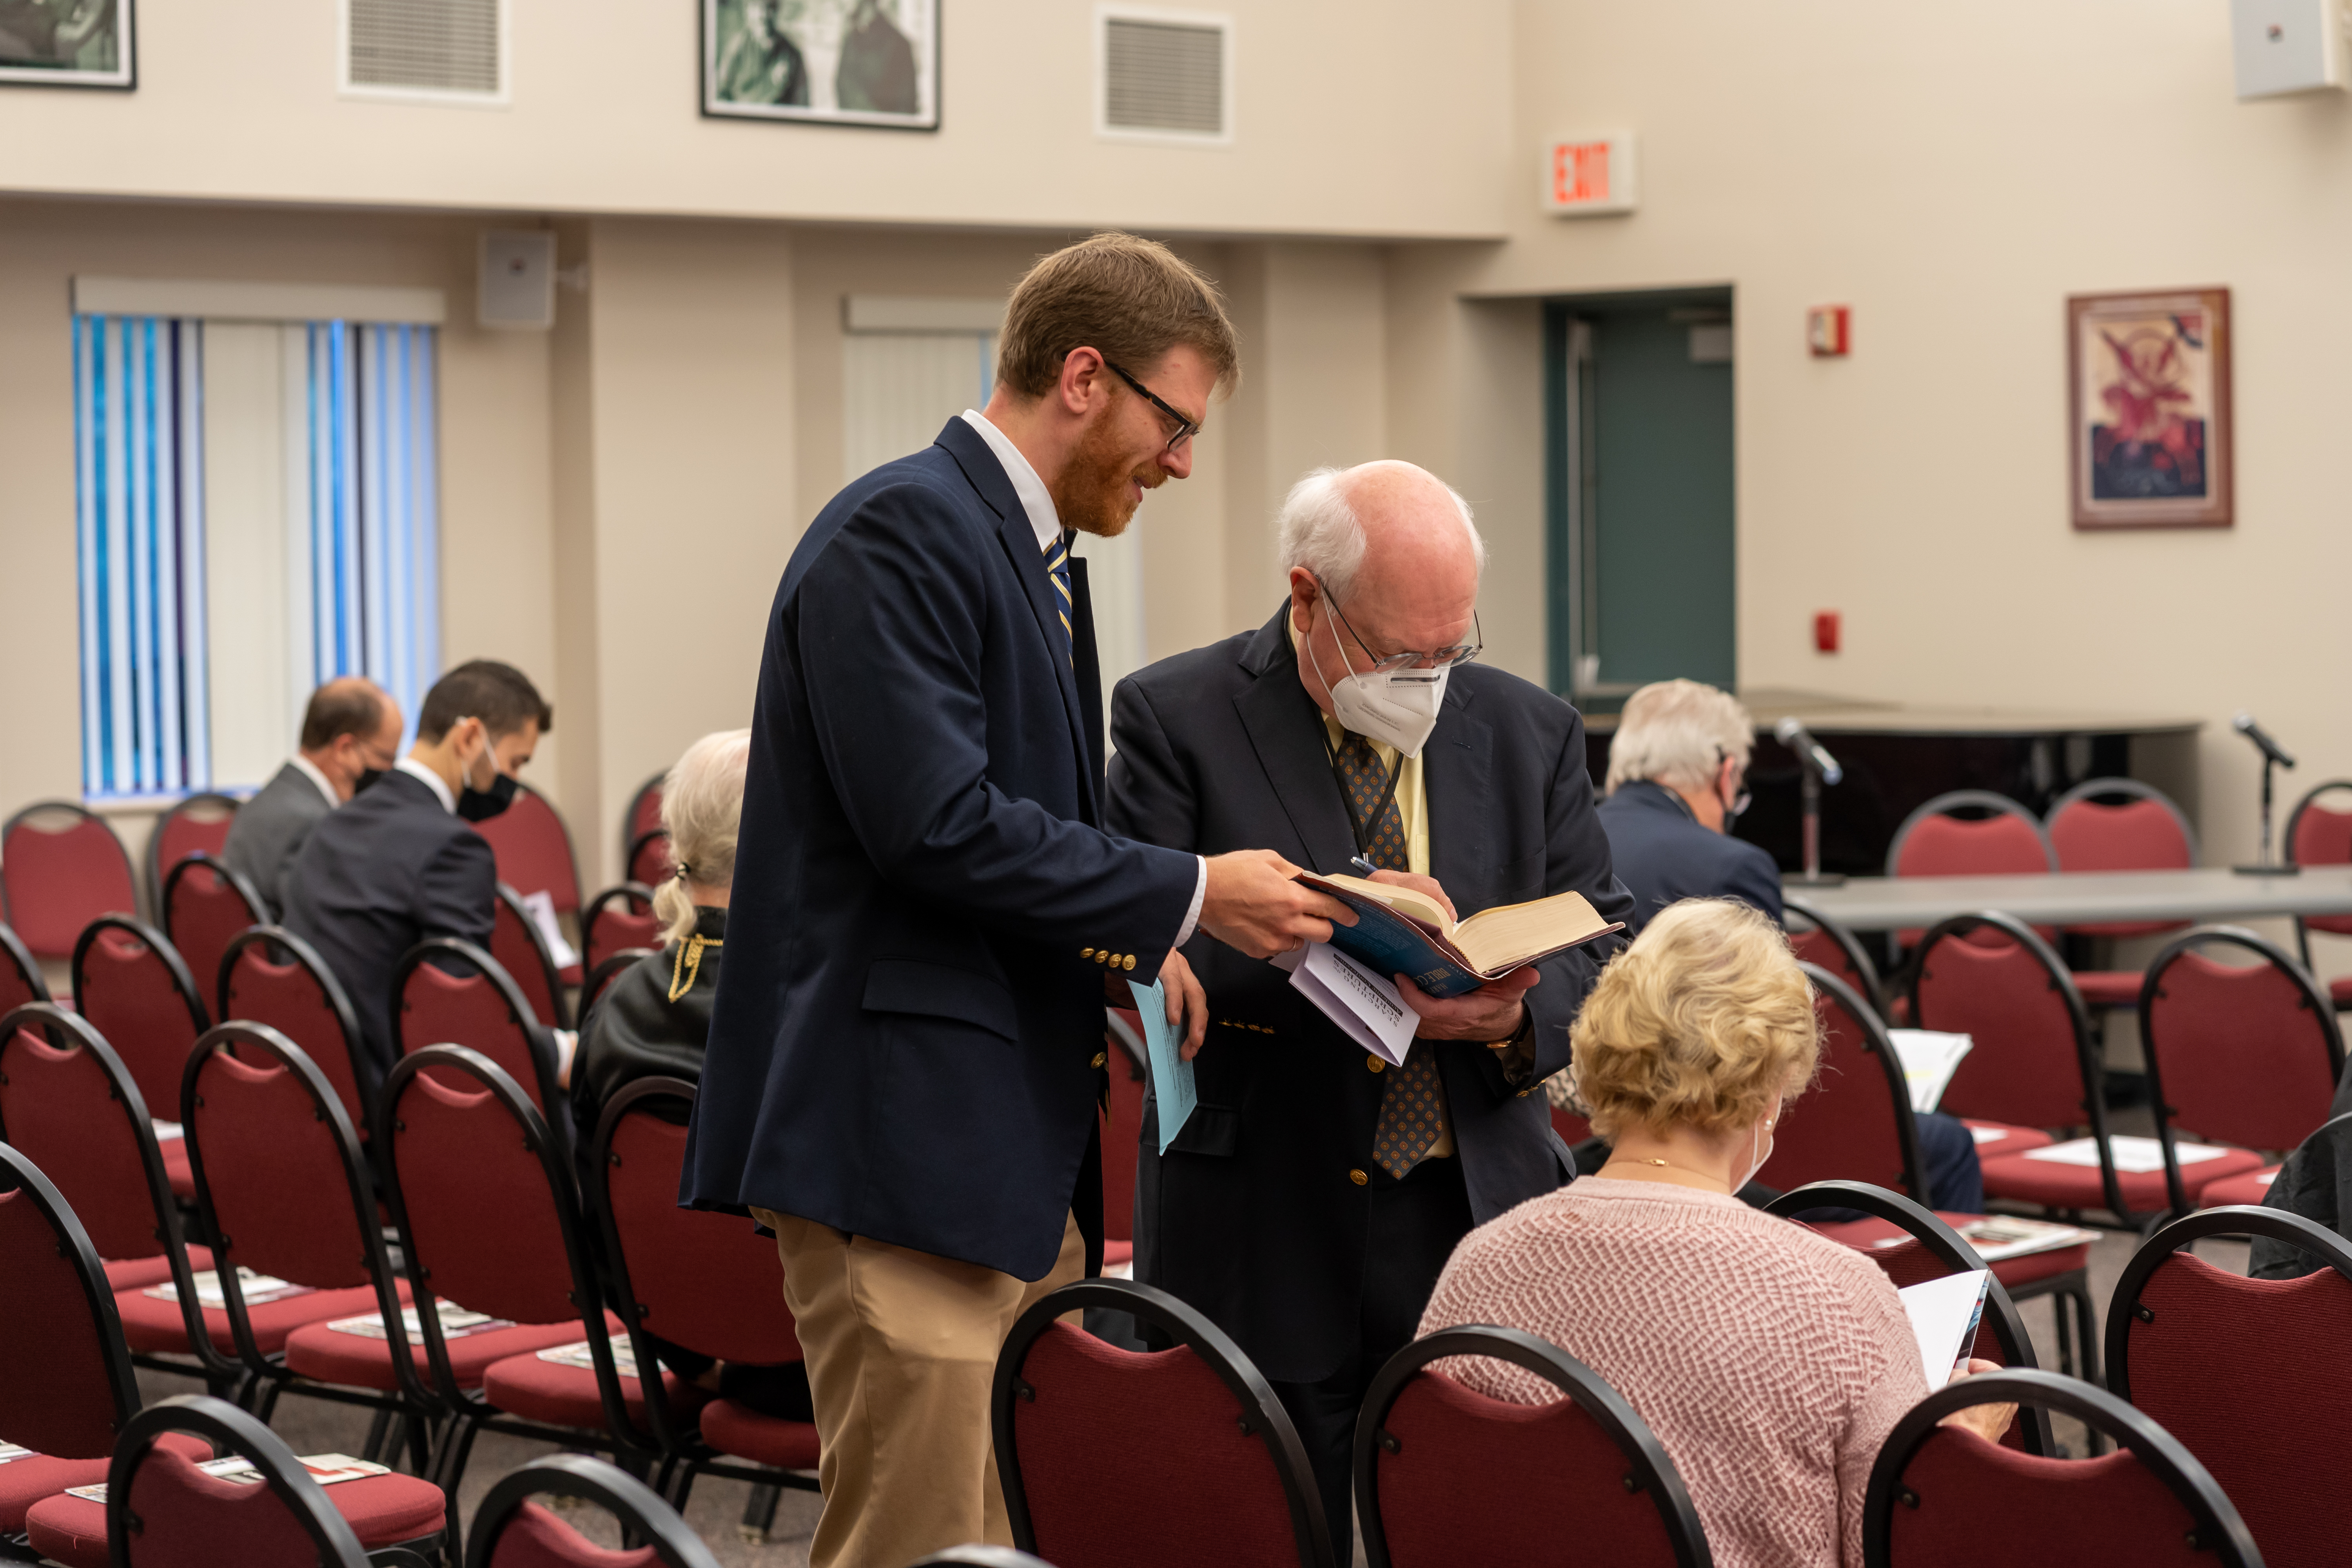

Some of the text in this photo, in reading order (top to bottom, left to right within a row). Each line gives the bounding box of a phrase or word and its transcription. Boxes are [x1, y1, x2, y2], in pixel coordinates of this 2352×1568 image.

[1553, 142, 1610, 203] EXIT
[1333, 965, 1341, 974] the
[1334, 955, 1371, 987] Conference
[1424, 968, 1451, 982] BIBLE
[1334, 960, 1400, 1022] SCRIPTURES
[1344, 975, 1398, 1027] SEARCHING
[1371, 986, 1402, 1014] Academic
